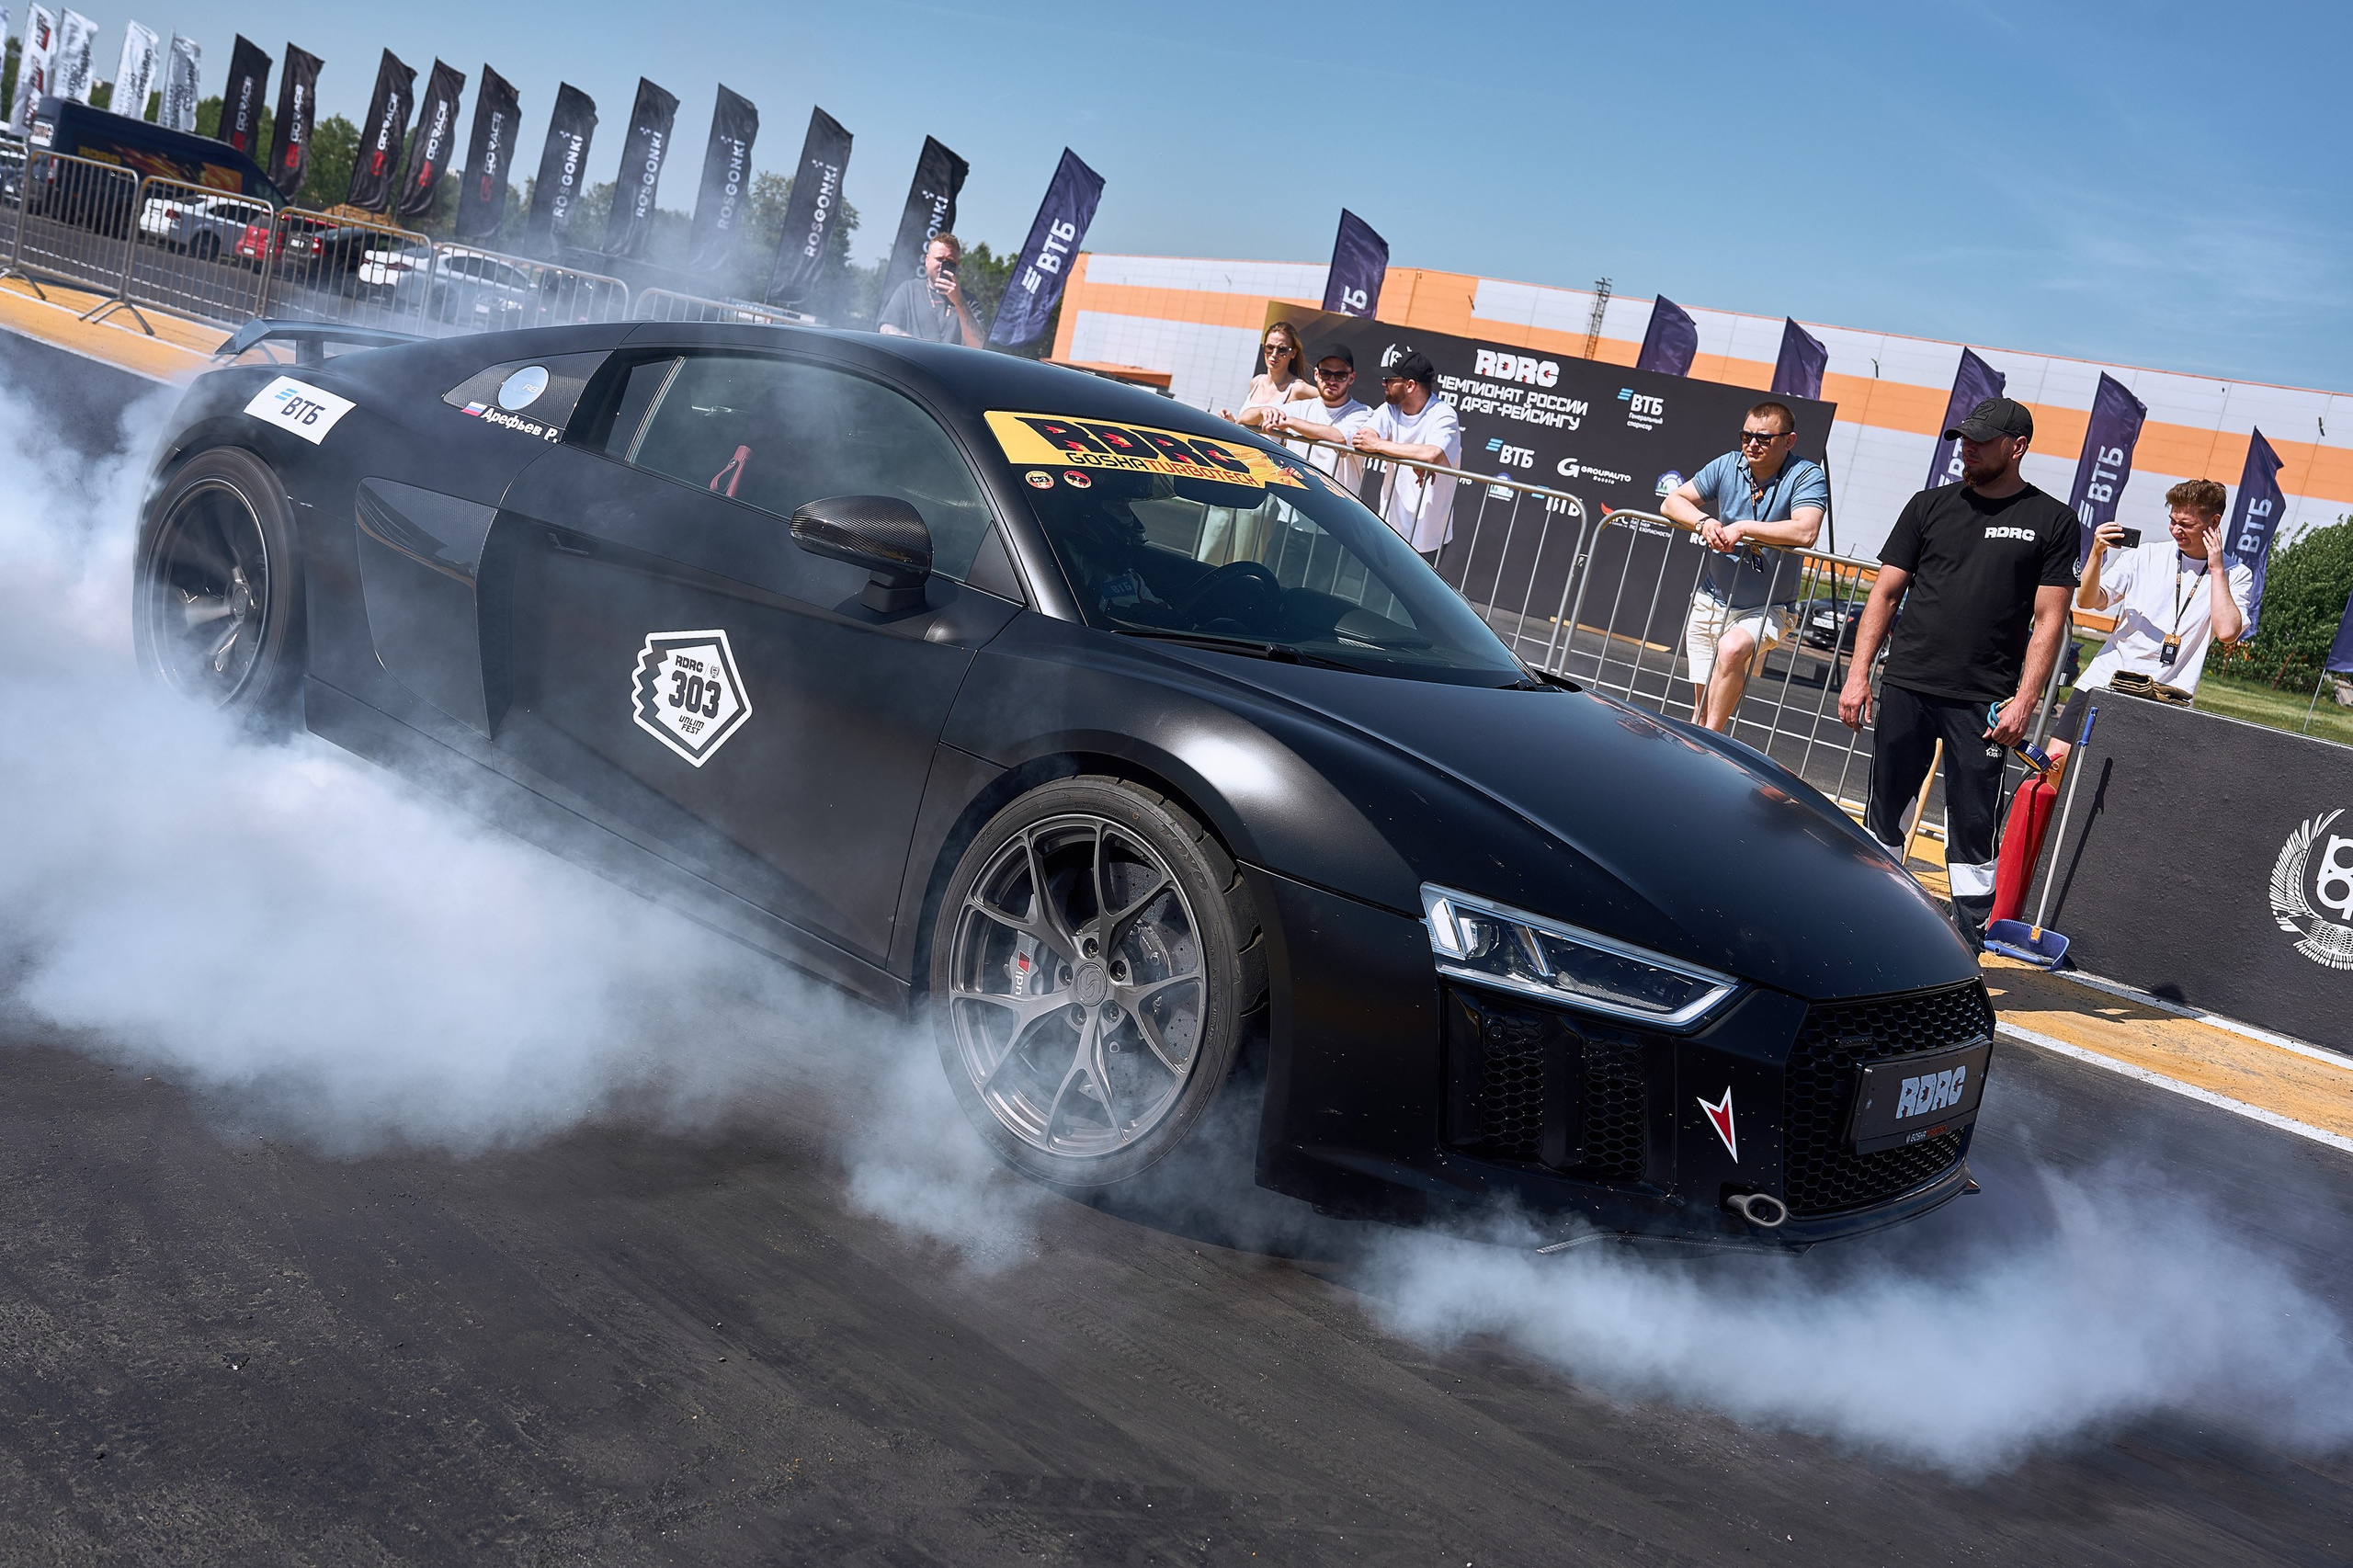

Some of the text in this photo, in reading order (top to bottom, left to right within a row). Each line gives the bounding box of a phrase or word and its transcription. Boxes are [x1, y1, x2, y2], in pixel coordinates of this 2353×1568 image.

[552, 134, 584, 218] ROSGONKI
[635, 131, 663, 218] ROSGONKI
[717, 139, 745, 230] ROSGONKI
[803, 164, 837, 257] ROSGONKI
[1035, 217, 1076, 275] ВТБ
[522, 383, 540, 393] R8
[1474, 348, 1561, 388] RDRC
[280, 396, 326, 426] ВТБ
[1437, 373, 1589, 416] ЧЕМПИОНАТ РОССИИ
[1438, 391, 1581, 431] ПО ДРЭГ-РЕЙСИНГУ
[1631, 393, 1664, 415] ВТБ
[480, 407, 543, 437] Арефьев
[1499, 444, 1535, 469] ВТБ
[1580, 465, 1631, 483] GROUPAUTO
[2086, 445, 2124, 504] ВТБ
[1984, 526, 2036, 542] RDRC
[2236, 497, 2272, 553] ВТБ
[675, 654, 704, 674] RDRC
[668, 669, 722, 720] 303
[678, 714, 705, 730] UNLIM
[680, 724, 701, 735] FEST
[1015, 971, 1025, 995] udi
[1895, 1065, 1966, 1119] RDRC
